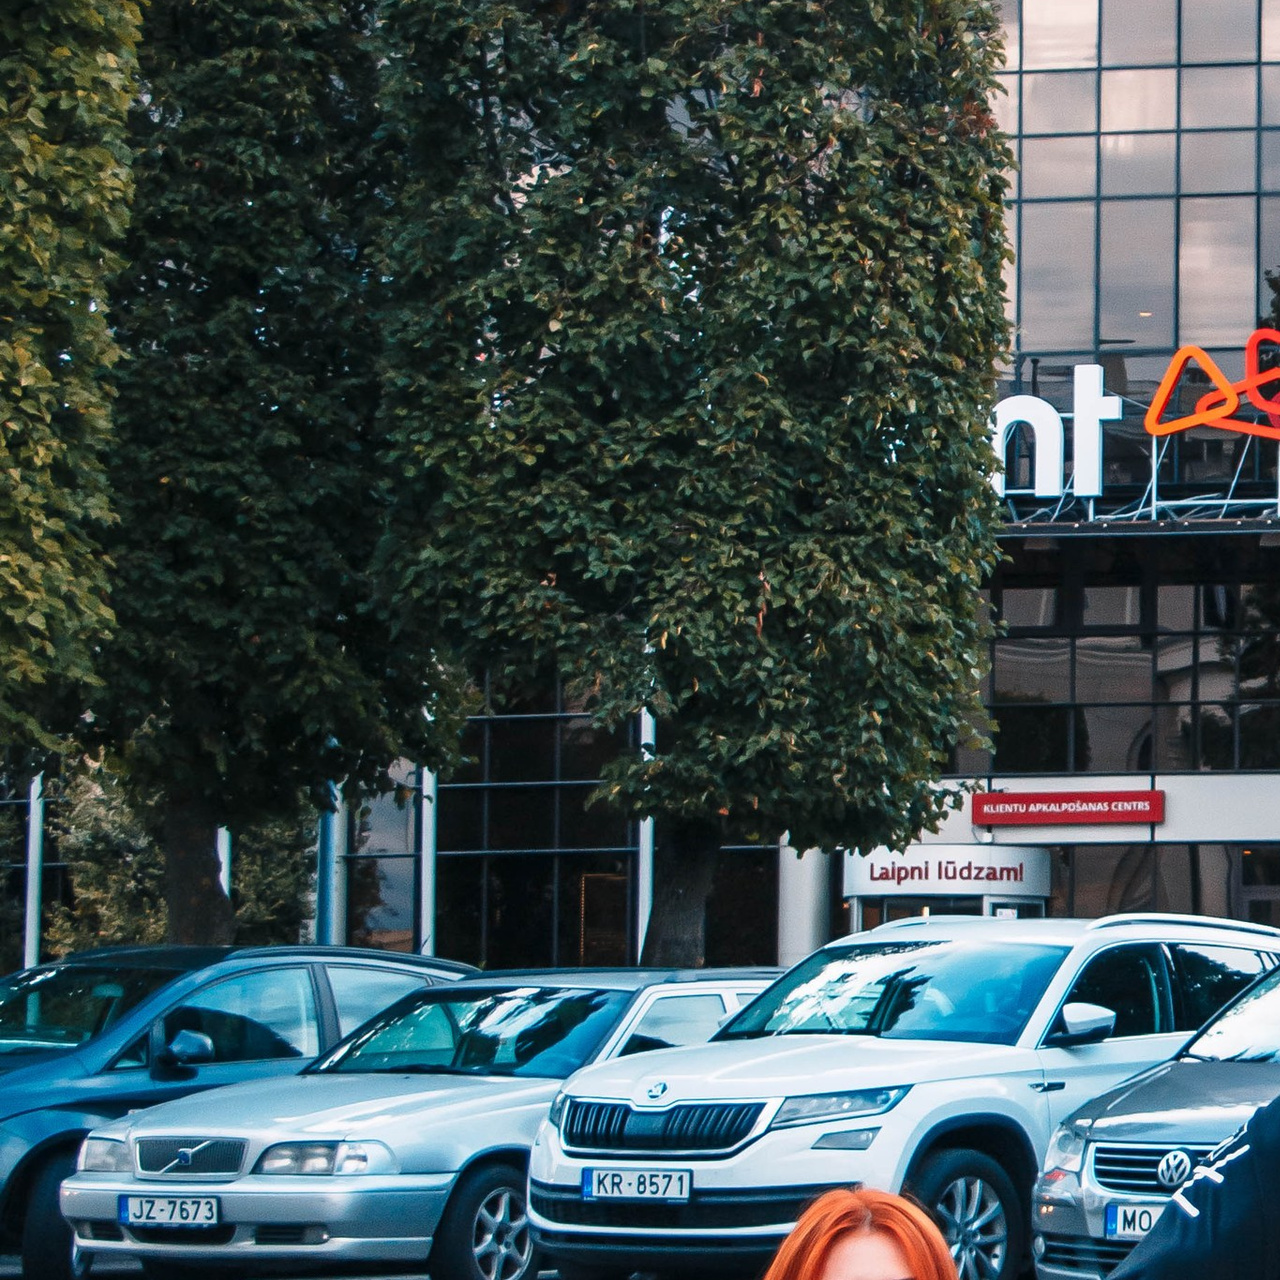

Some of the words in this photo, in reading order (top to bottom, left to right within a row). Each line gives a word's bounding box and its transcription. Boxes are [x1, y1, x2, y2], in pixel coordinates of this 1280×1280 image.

[983, 803, 1027, 813] KLIENTU
[1028, 800, 1109, 812] APKALPOŠANAS
[1111, 801, 1150, 812] CENTRS
[870, 862, 929, 885] Laipni
[938, 860, 1024, 882] lūdzam!
[597, 1172, 684, 1196] KR-8571
[133, 1200, 214, 1221] JZ-7673
[1122, 1209, 1153, 1232] MO
